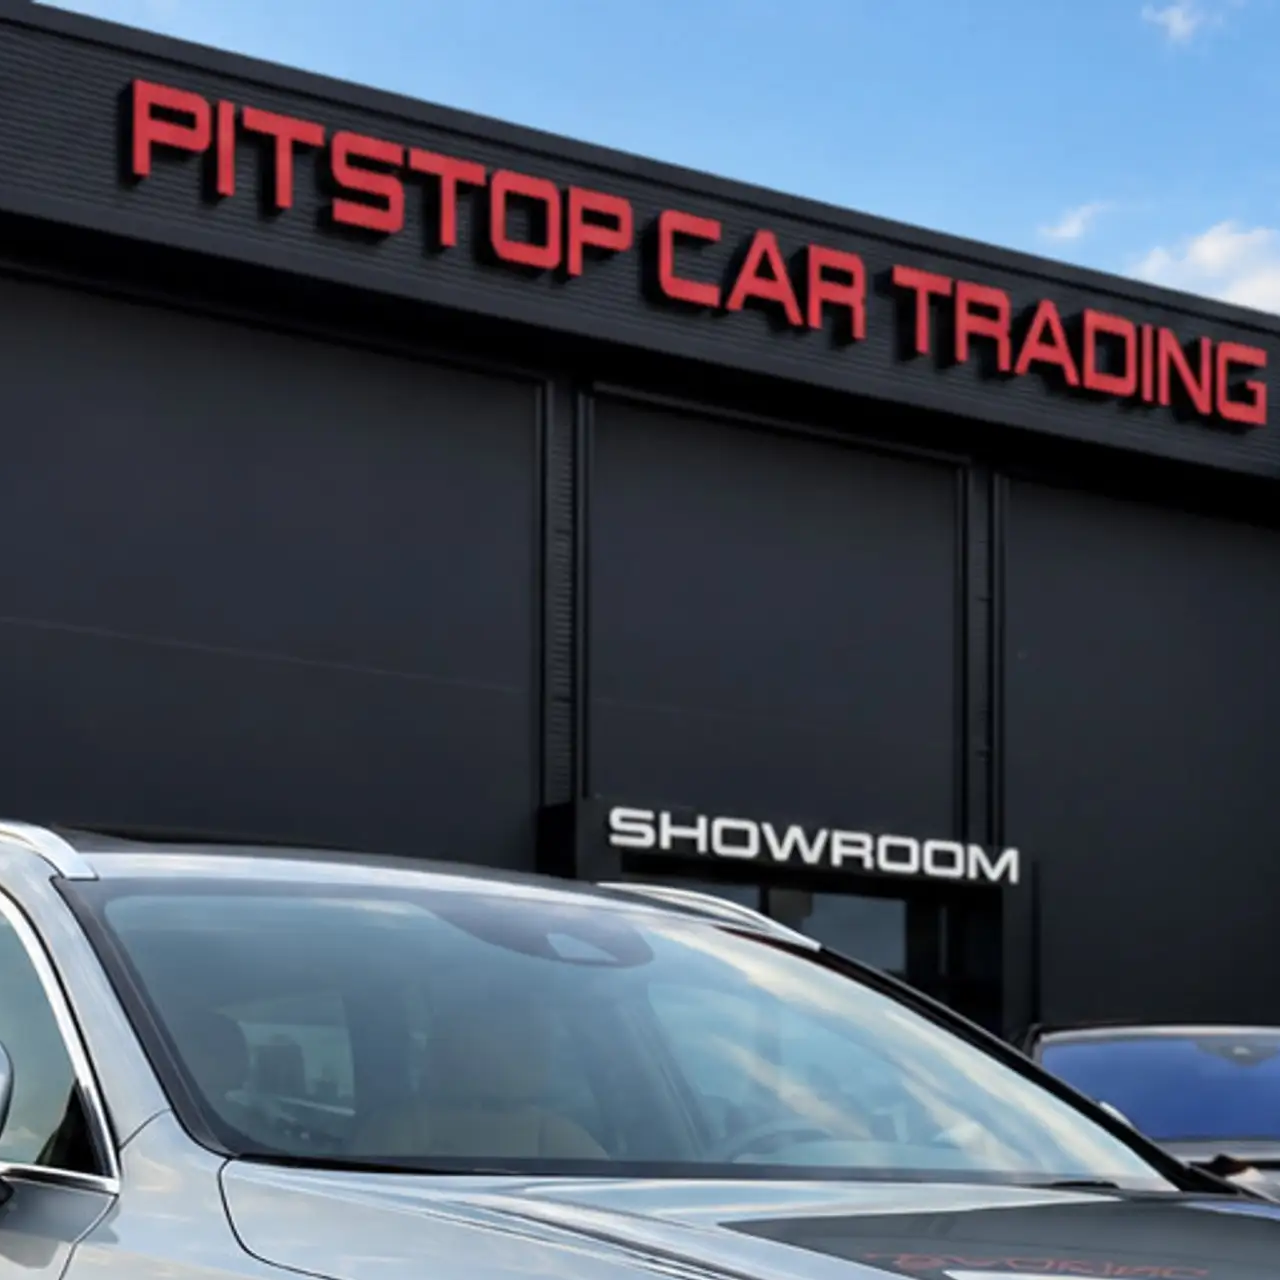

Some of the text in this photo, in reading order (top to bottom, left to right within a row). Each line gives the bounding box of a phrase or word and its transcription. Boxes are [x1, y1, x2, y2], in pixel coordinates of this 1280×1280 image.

[132, 79, 1268, 425] PITSTOP CAR TRADING
[608, 807, 1019, 884] SHOWROOM
